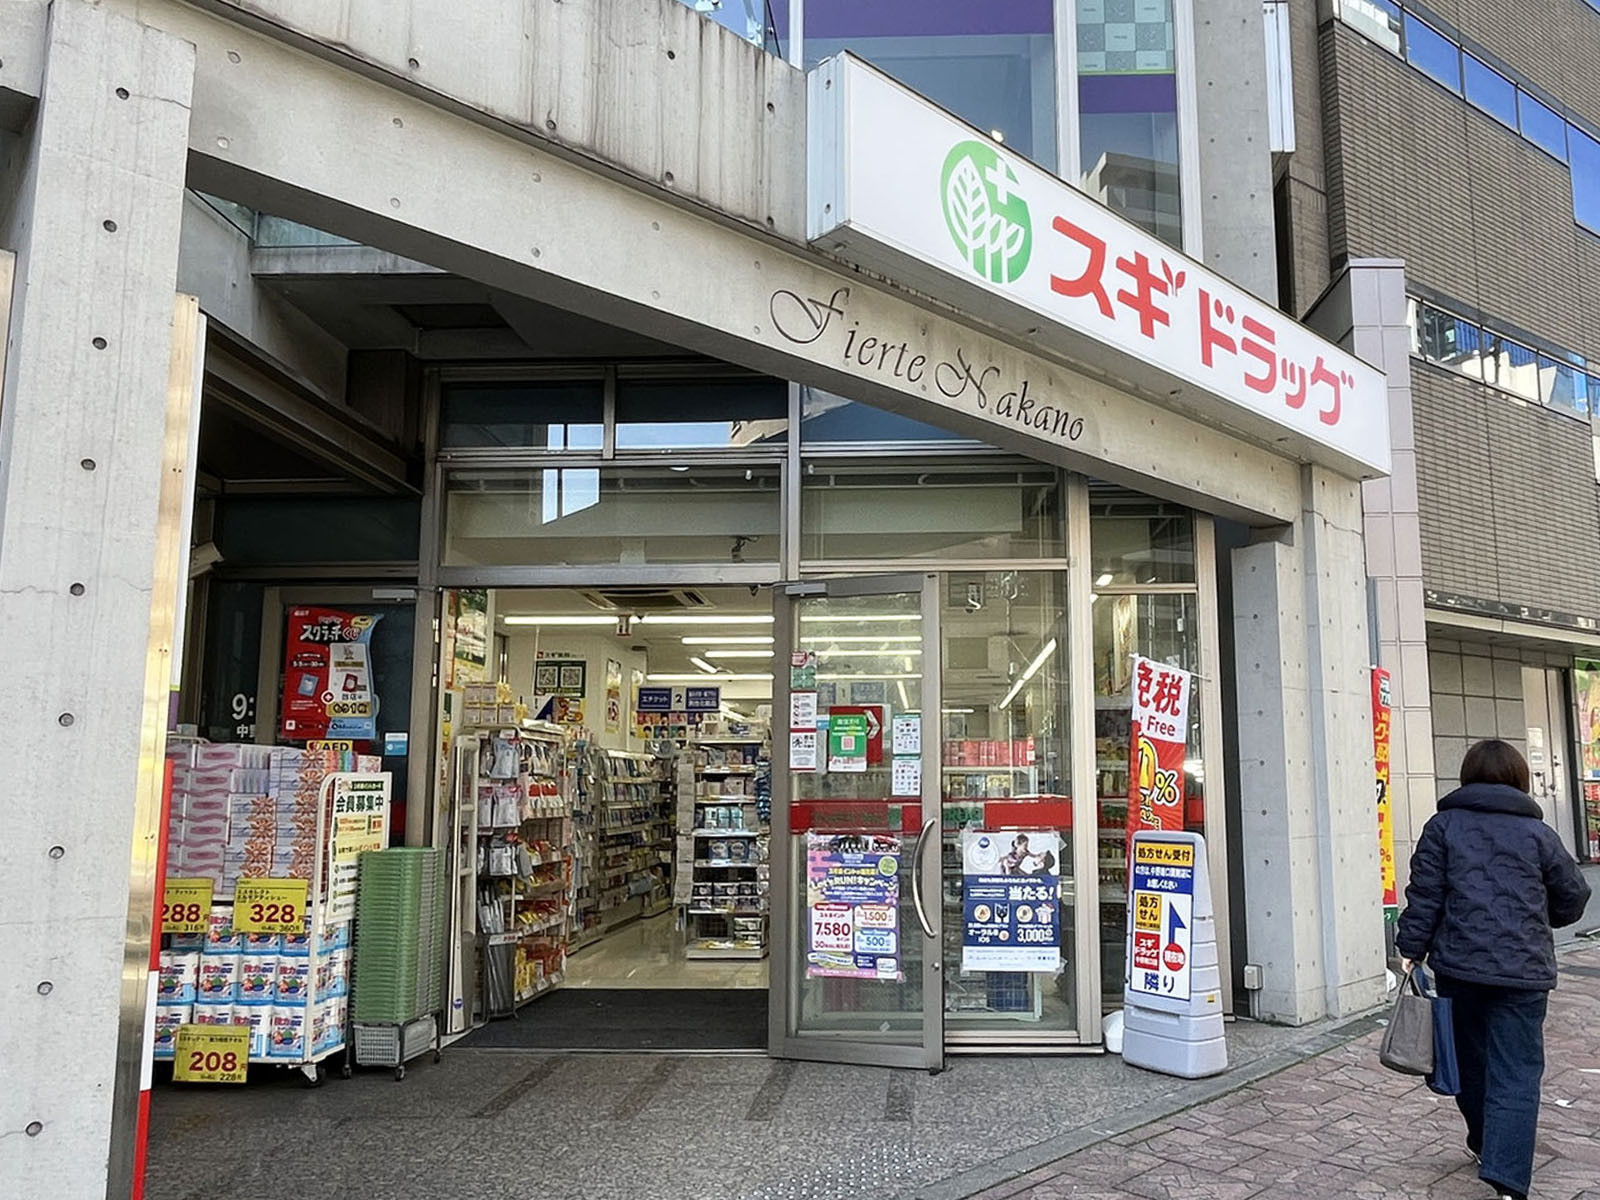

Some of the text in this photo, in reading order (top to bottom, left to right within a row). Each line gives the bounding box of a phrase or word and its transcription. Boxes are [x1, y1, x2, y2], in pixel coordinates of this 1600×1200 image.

[769, 287, 1084, 442] Fierte Nakano
[675, 693, 683, 704] 2
[1147, 715, 1176, 737] Free
[322, 742, 350, 751] AED
[336, 795, 384, 814] 会員募集中
[1138, 846, 1191, 862] 処方せん受付
[1139, 896, 1159, 908] 処方
[1139, 908, 1159, 921] せん
[1143, 972, 1175, 993] 隣り
